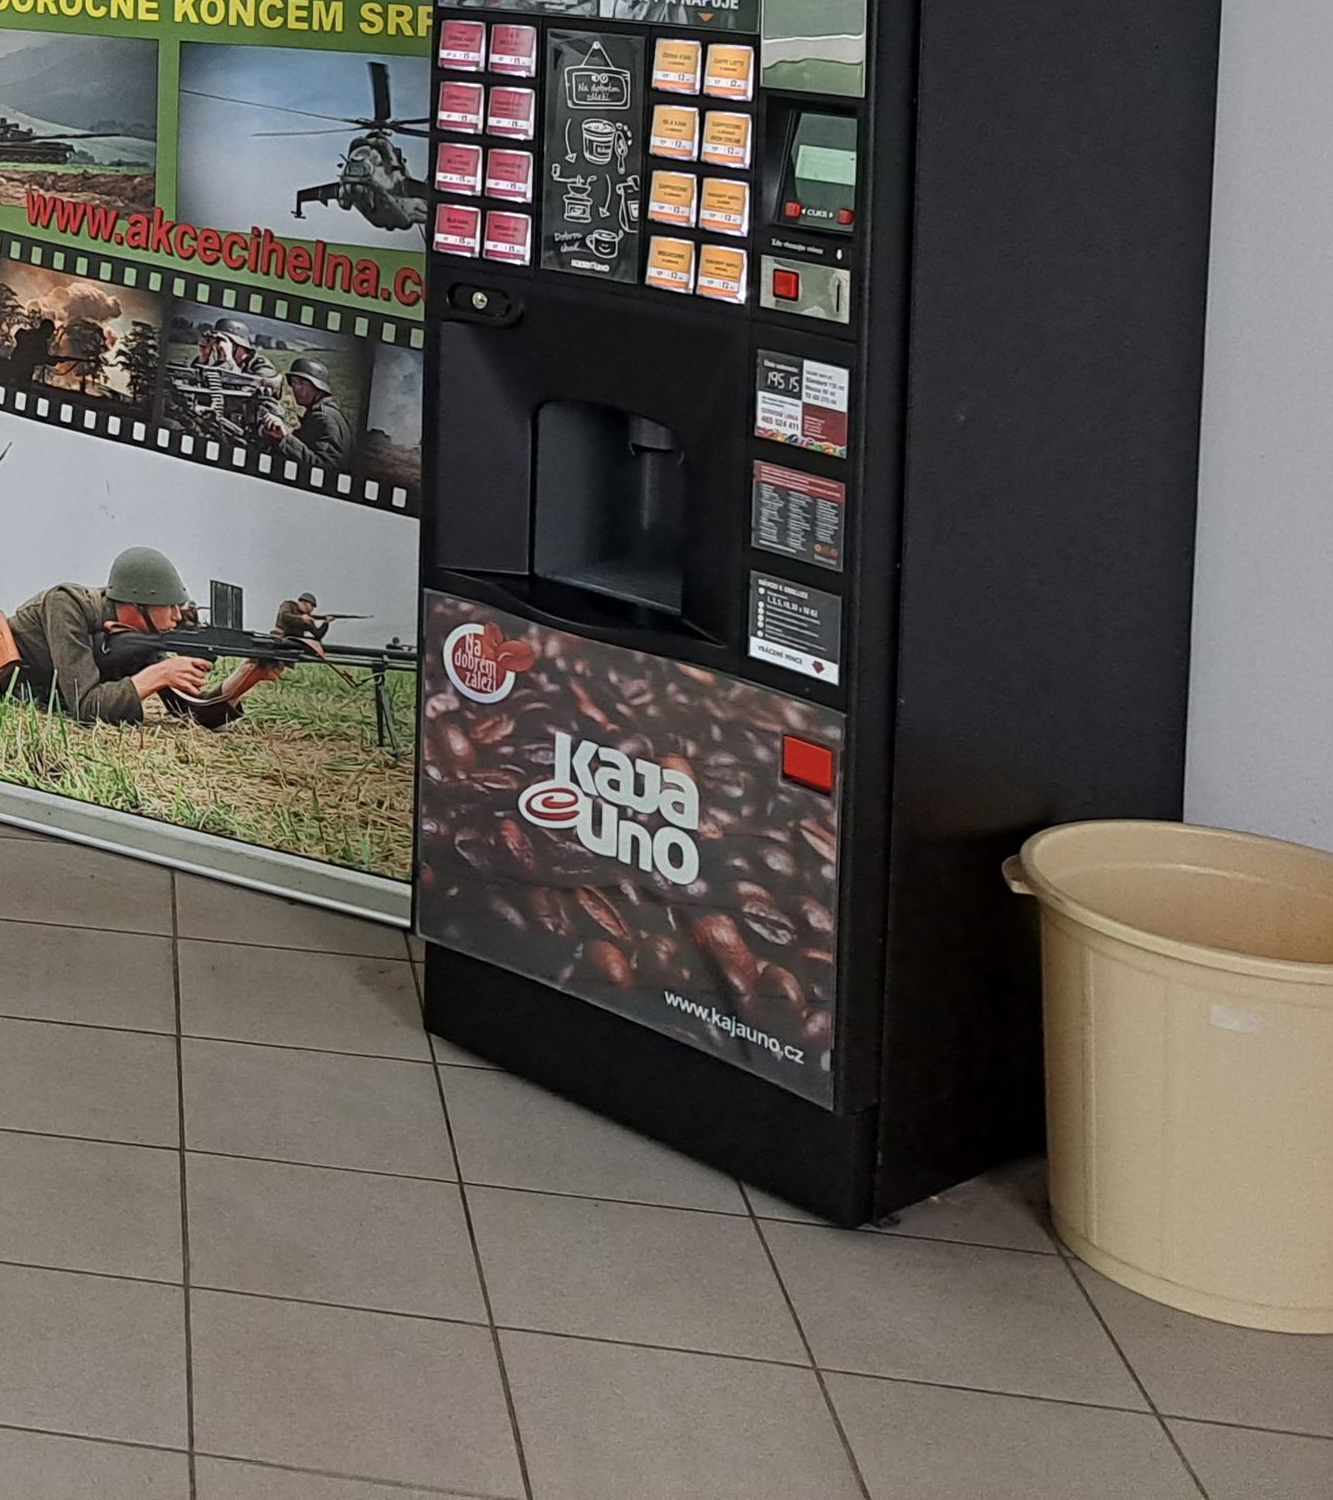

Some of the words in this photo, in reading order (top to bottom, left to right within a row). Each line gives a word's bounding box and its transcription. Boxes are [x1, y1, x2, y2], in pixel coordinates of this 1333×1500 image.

[24, 188, 426, 307] www.akcecihelna.c
[465, 633, 482, 657] Na
[663, 990, 805, 1065] www.kajauno.cz
